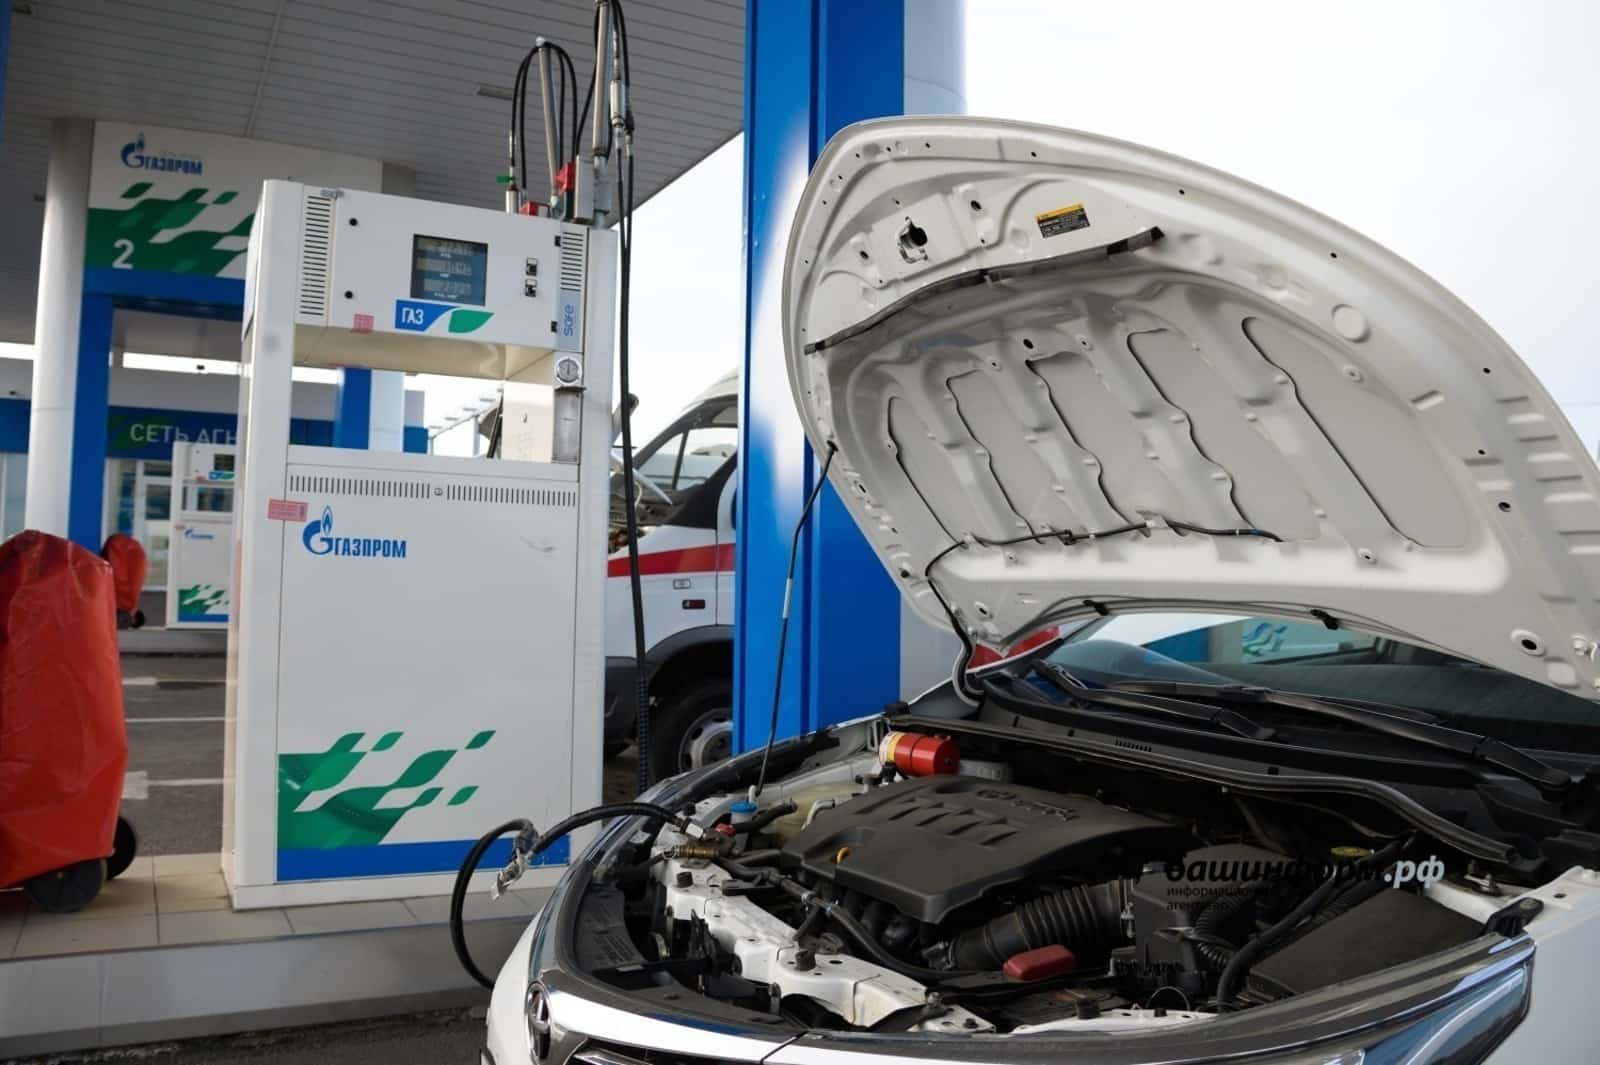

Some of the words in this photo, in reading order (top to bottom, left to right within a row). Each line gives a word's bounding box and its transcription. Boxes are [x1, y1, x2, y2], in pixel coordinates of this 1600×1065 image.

[112, 239, 136, 269] 2
[401, 306, 425, 325] ГАЗ
[129, 423, 189, 444] СЕТЬ
[333, 537, 408, 559] ГАЗПРОМ
